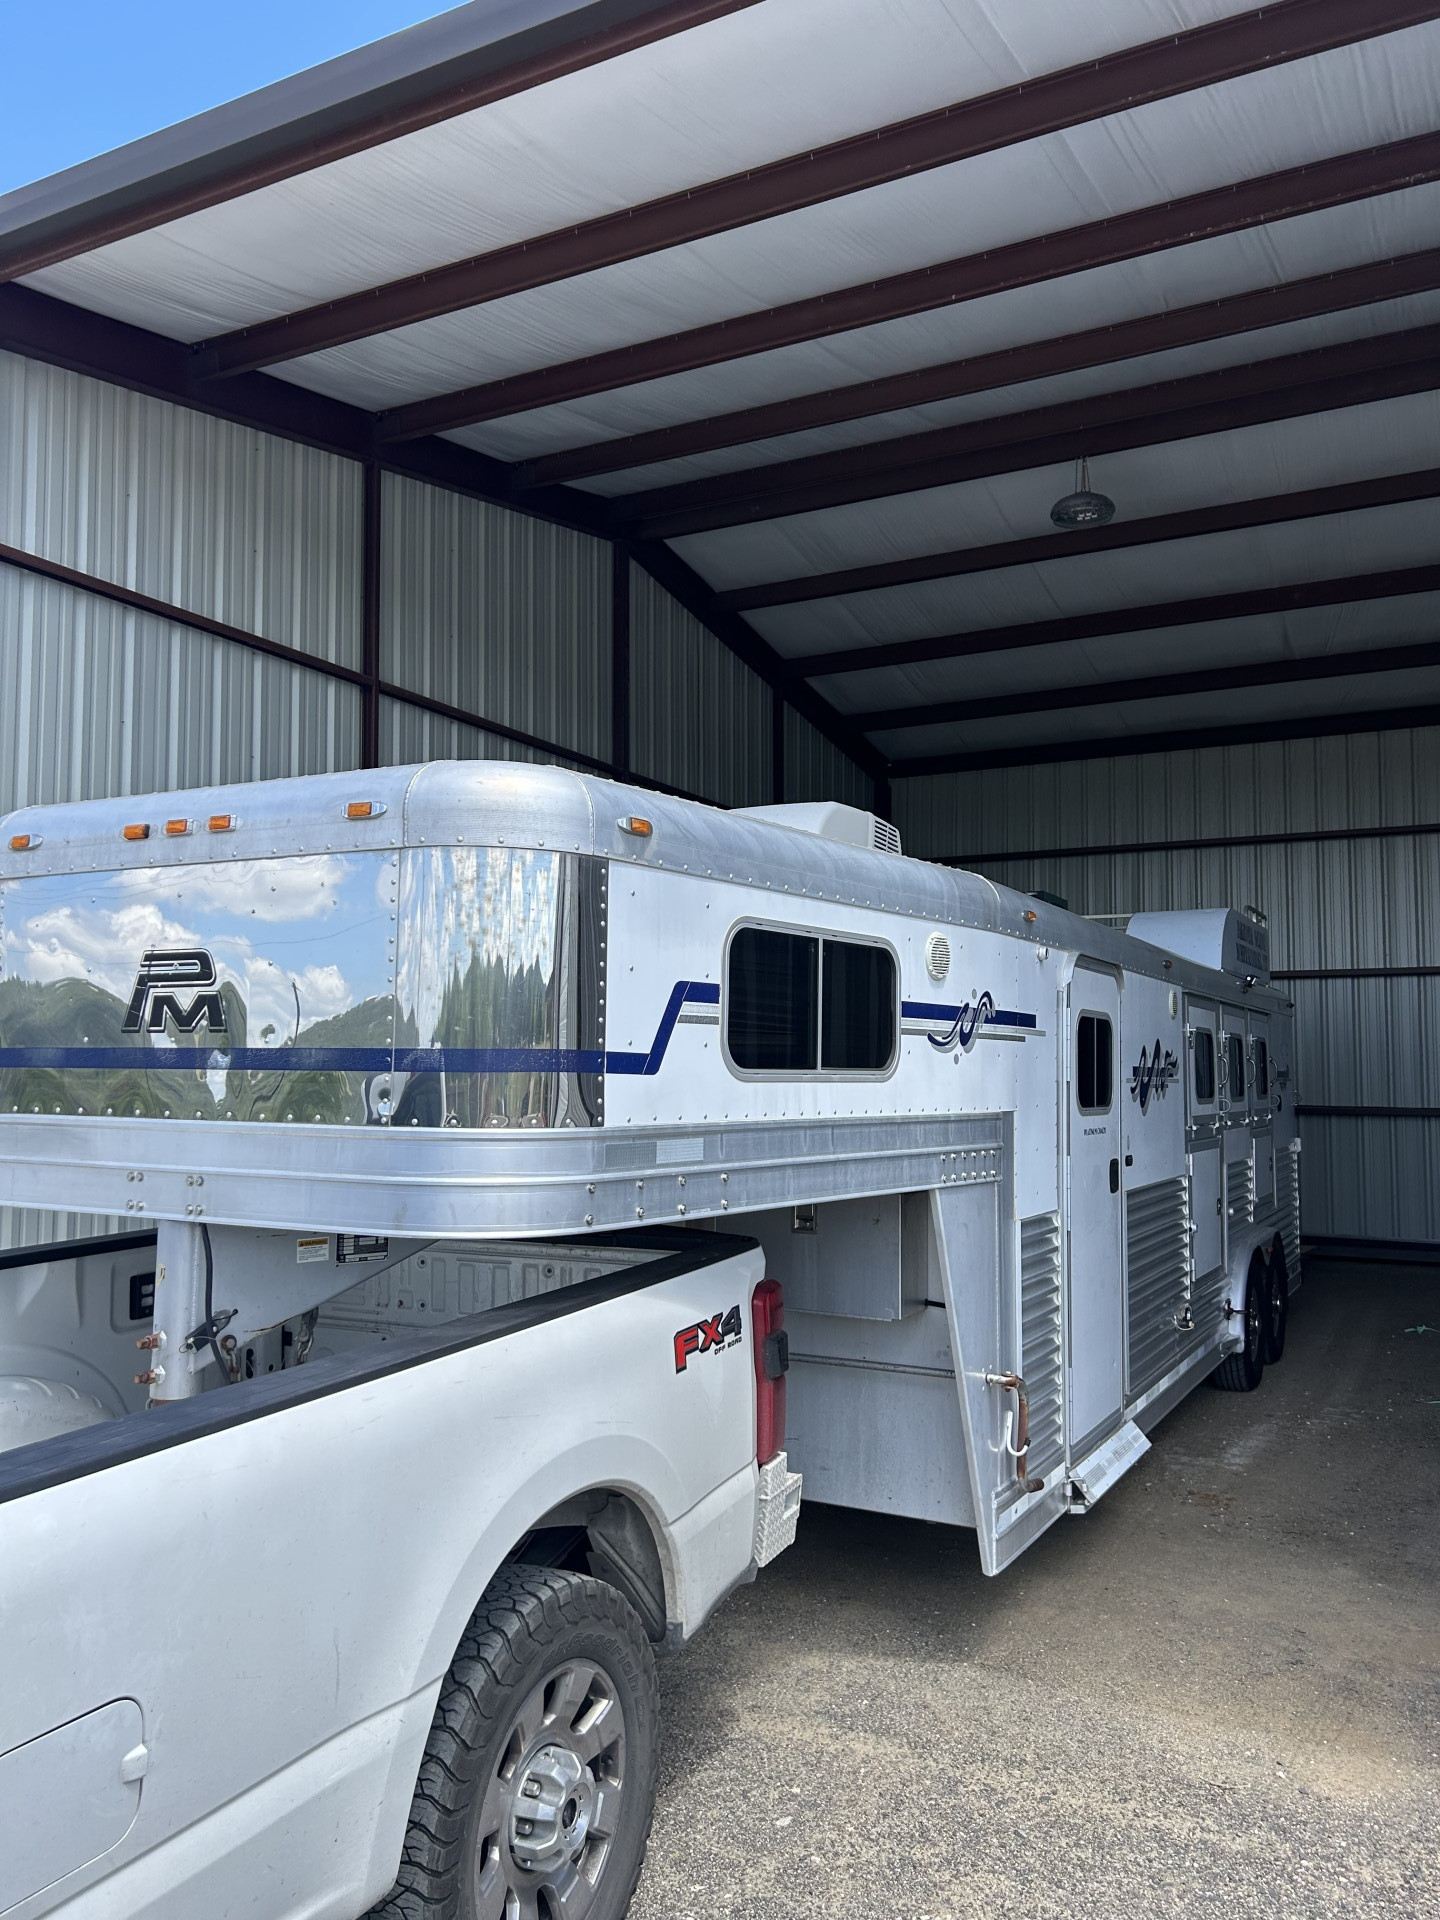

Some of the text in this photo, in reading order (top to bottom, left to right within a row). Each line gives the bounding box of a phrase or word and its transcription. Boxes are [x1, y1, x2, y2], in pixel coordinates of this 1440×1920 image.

[121, 948, 228, 1033] PM
[674, 1304, 742, 1374] FX4
[714, 1336, 742, 1355] OFF ROAD
